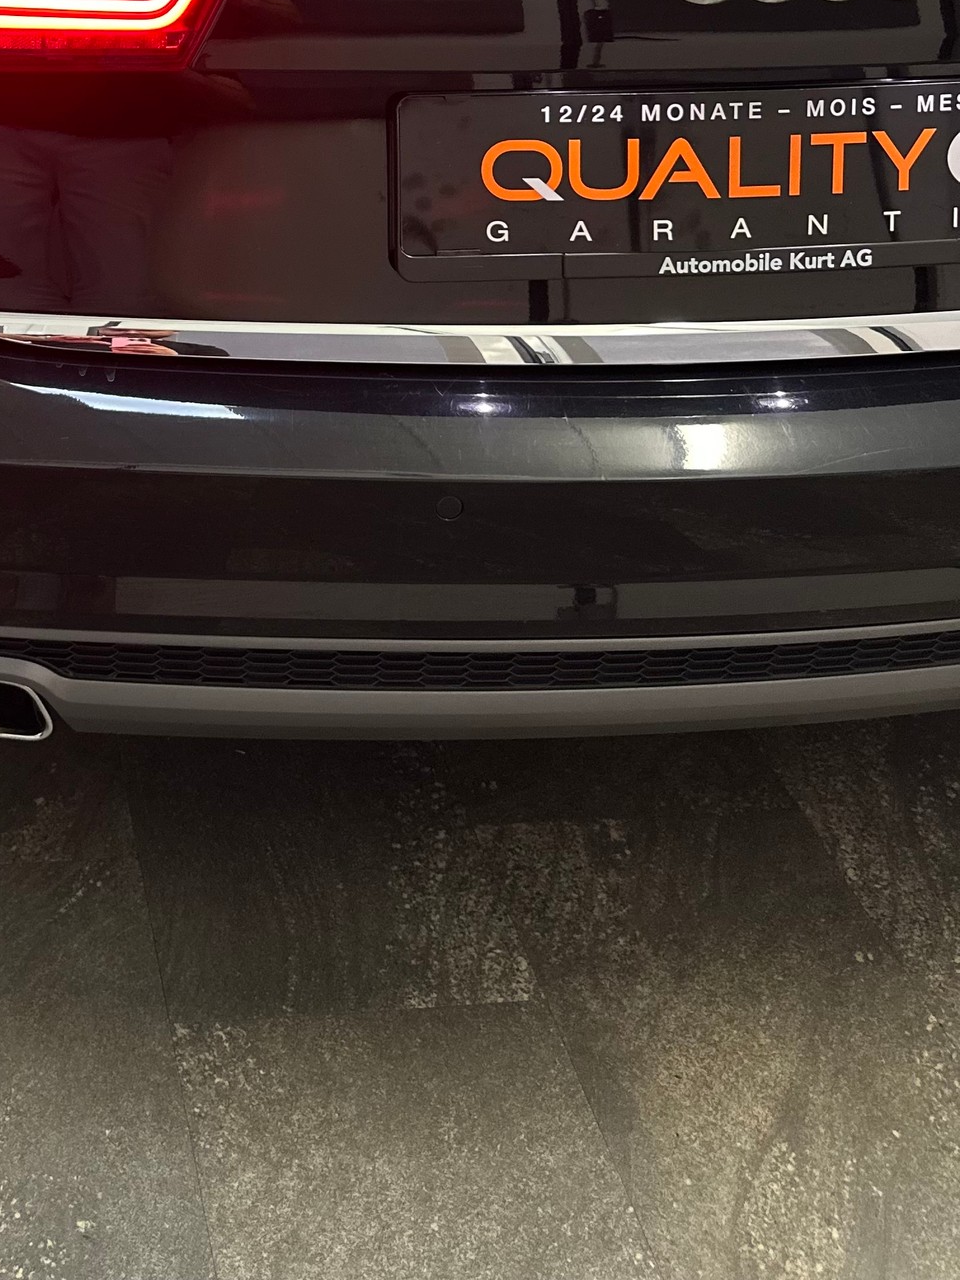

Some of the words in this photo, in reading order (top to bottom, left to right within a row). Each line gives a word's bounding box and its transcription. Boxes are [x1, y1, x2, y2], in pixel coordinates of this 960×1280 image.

[541, 103, 624, 123] 12/24
[640, 101, 763, 122] MONATE
[806, 97, 876, 118] MOIS
[481, 128, 938, 202] QUALITY
[658, 252, 783, 275] Automobile
[789, 251, 835, 270] Kurt
[839, 248, 873, 269] AG
